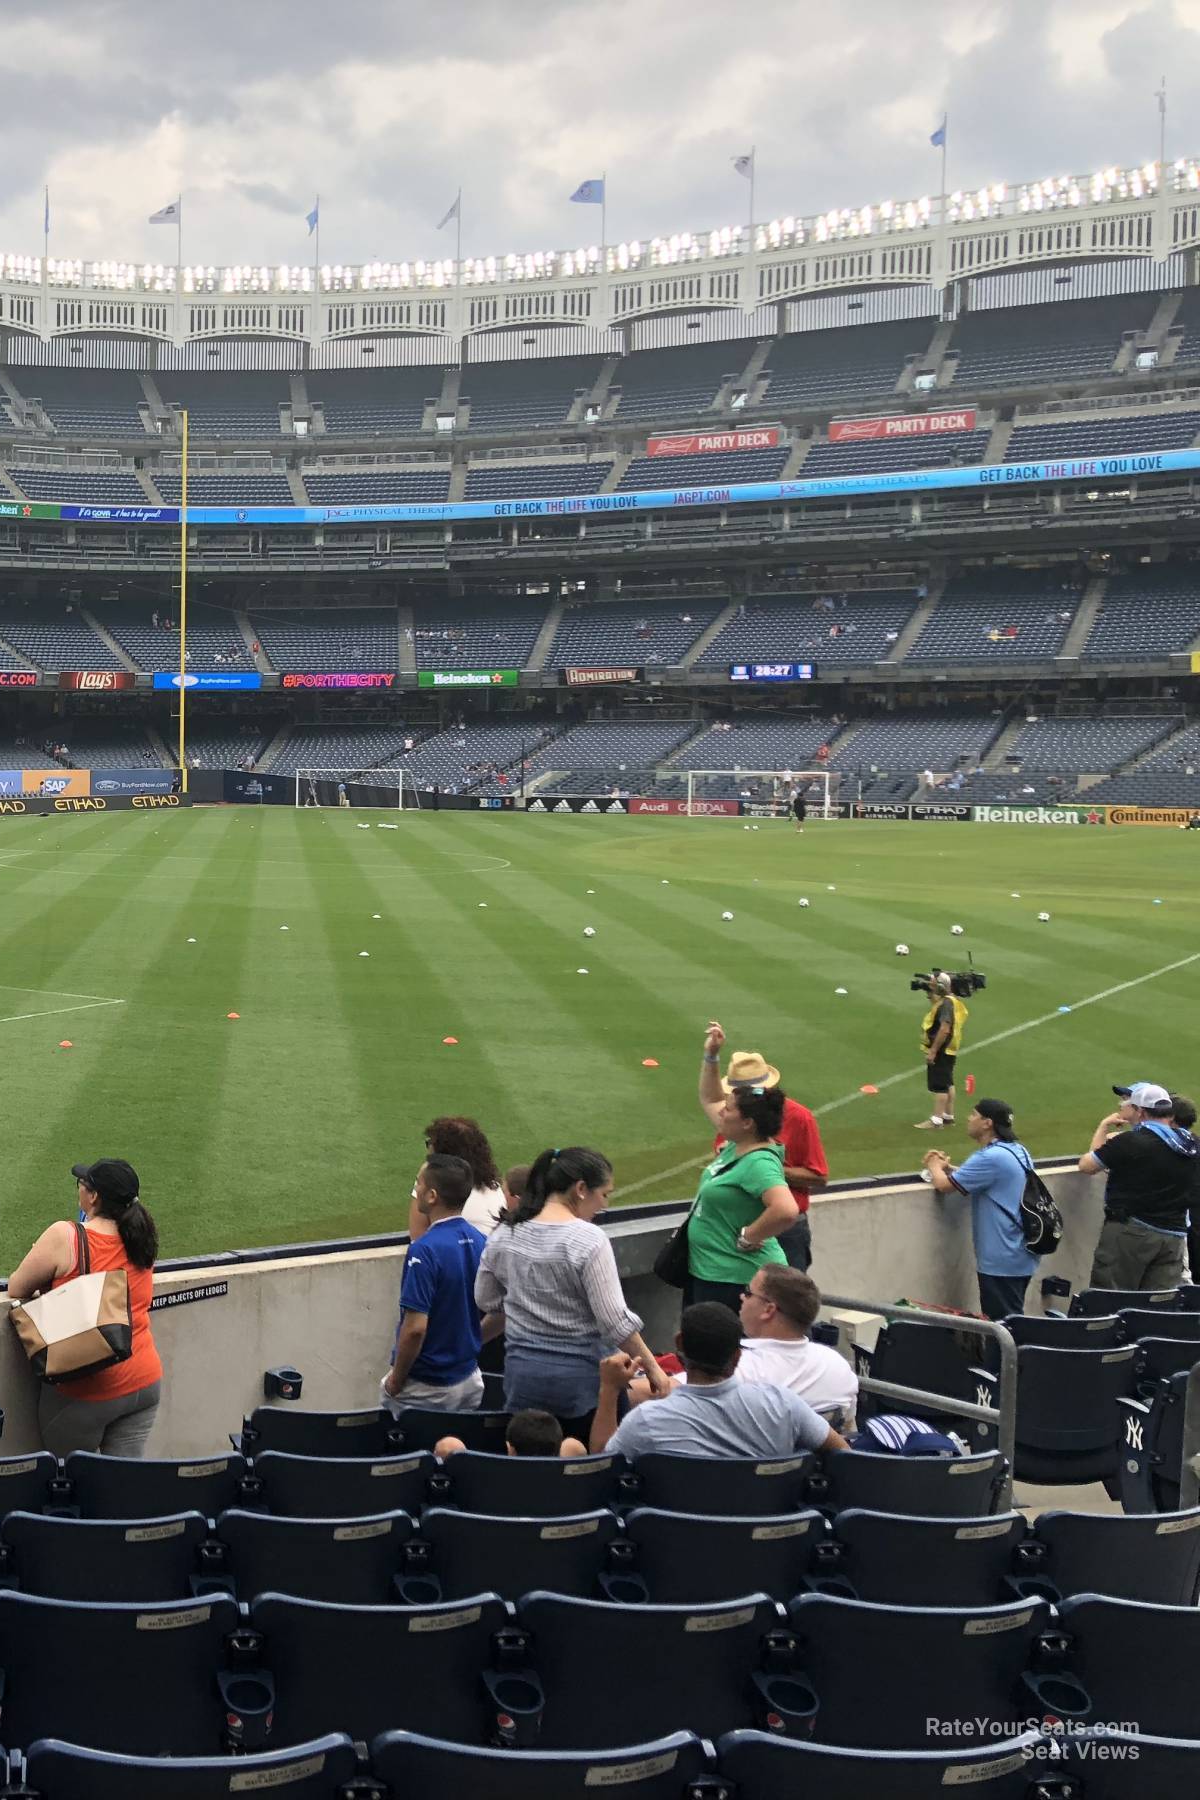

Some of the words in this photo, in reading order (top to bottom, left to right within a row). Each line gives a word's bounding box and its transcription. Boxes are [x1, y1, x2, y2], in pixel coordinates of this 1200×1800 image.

[886, 418, 928, 434] PARTY
[930, 414, 967, 430] DECK
[698, 436, 735, 449] PARTY
[737, 432, 770, 446] DECK
[980, 470, 1003, 483] GET
[1006, 466, 1040, 480] BACK
[1044, 464, 1067, 478] THE
[1071, 462, 1097, 476] LIFE
[1100, 459, 1128, 474] YOU
[1131, 456, 1163, 471] LOVE
[673, 490, 730, 505] JAGPT.COM
[494, 503, 511, 515] GET
[515, 502, 542, 514] BACK
[546, 501, 564, 512] THE
[568, 499, 587, 511] LIFE
[590, 498, 610, 510] YOU
[613, 496, 638, 508] LOVE
[283, 674, 395, 688] #FORTHECITY
[433, 673, 490, 685] Heineken
[569, 668, 635, 683] ADMIRATION
[45, 780, 65, 792] SAP
[121, 781, 168, 789] BuyFordNow.com
[54, 797, 106, 811] ETIHAD
[131, 795, 180, 808] ETIHAD
[640, 802, 668, 811] Audi
[856, 805, 905, 814] ETIHAD
[914, 806, 966, 815] ETIHAD
[974, 806, 1080, 824] Heineken
[1110, 809, 1190, 825] Continental
[152, 1297, 167, 1307] KEEP
[168, 1291, 194, 1304] OBJECTS
[194, 1288, 205, 1298] OFF
[205, 1283, 227, 1296] LEDGES
